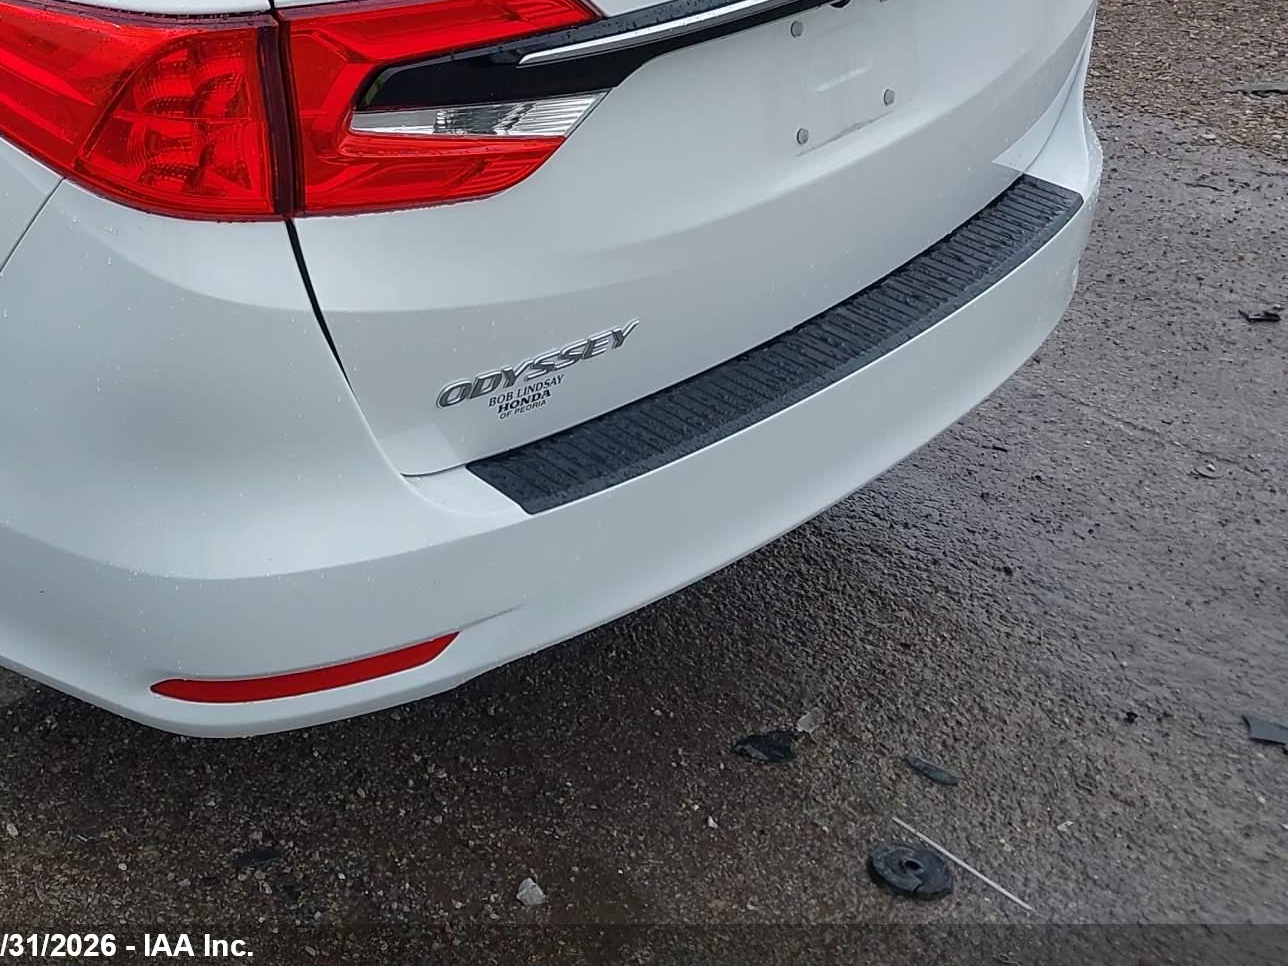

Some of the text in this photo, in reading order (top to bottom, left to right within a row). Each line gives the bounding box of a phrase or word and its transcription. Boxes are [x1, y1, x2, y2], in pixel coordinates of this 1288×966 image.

[438, 318, 639, 408] ODYSSEY
[488, 374, 565, 408] BOB LINDSAY
[497, 389, 551, 414] HONDA
[499, 400, 547, 420] OF PEORIA
